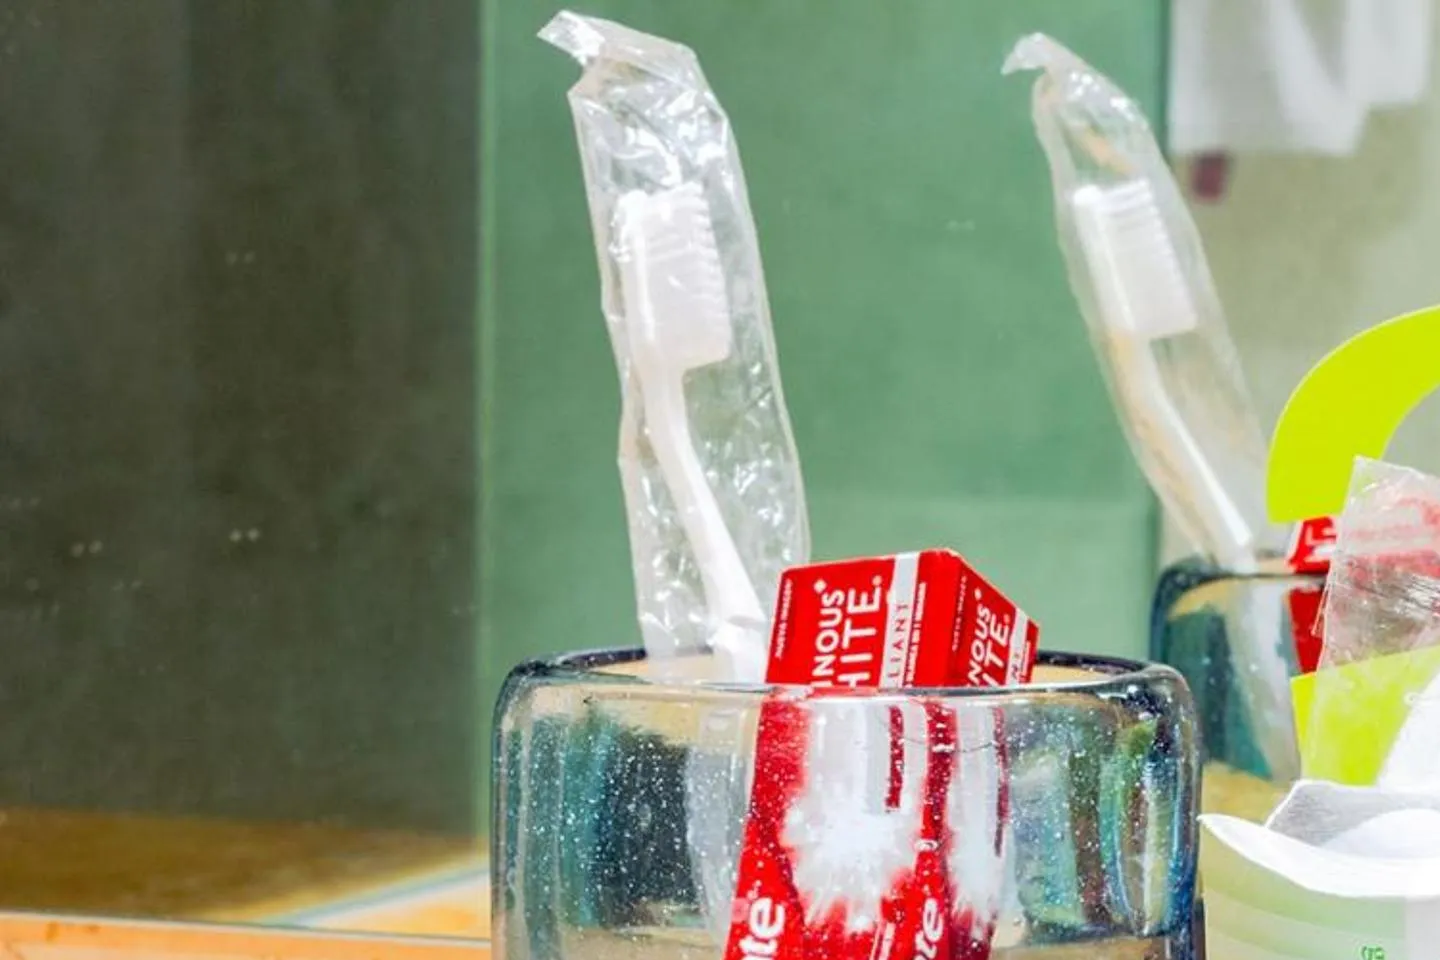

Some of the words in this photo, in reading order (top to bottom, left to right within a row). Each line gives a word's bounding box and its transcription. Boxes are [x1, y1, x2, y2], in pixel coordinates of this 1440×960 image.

[811, 589, 846, 688] INOUS
[837, 586, 882, 688] HITE
[887, 602, 909, 680] LIANT
[967, 603, 991, 685] NOUS
[981, 613, 1009, 686] ITE
